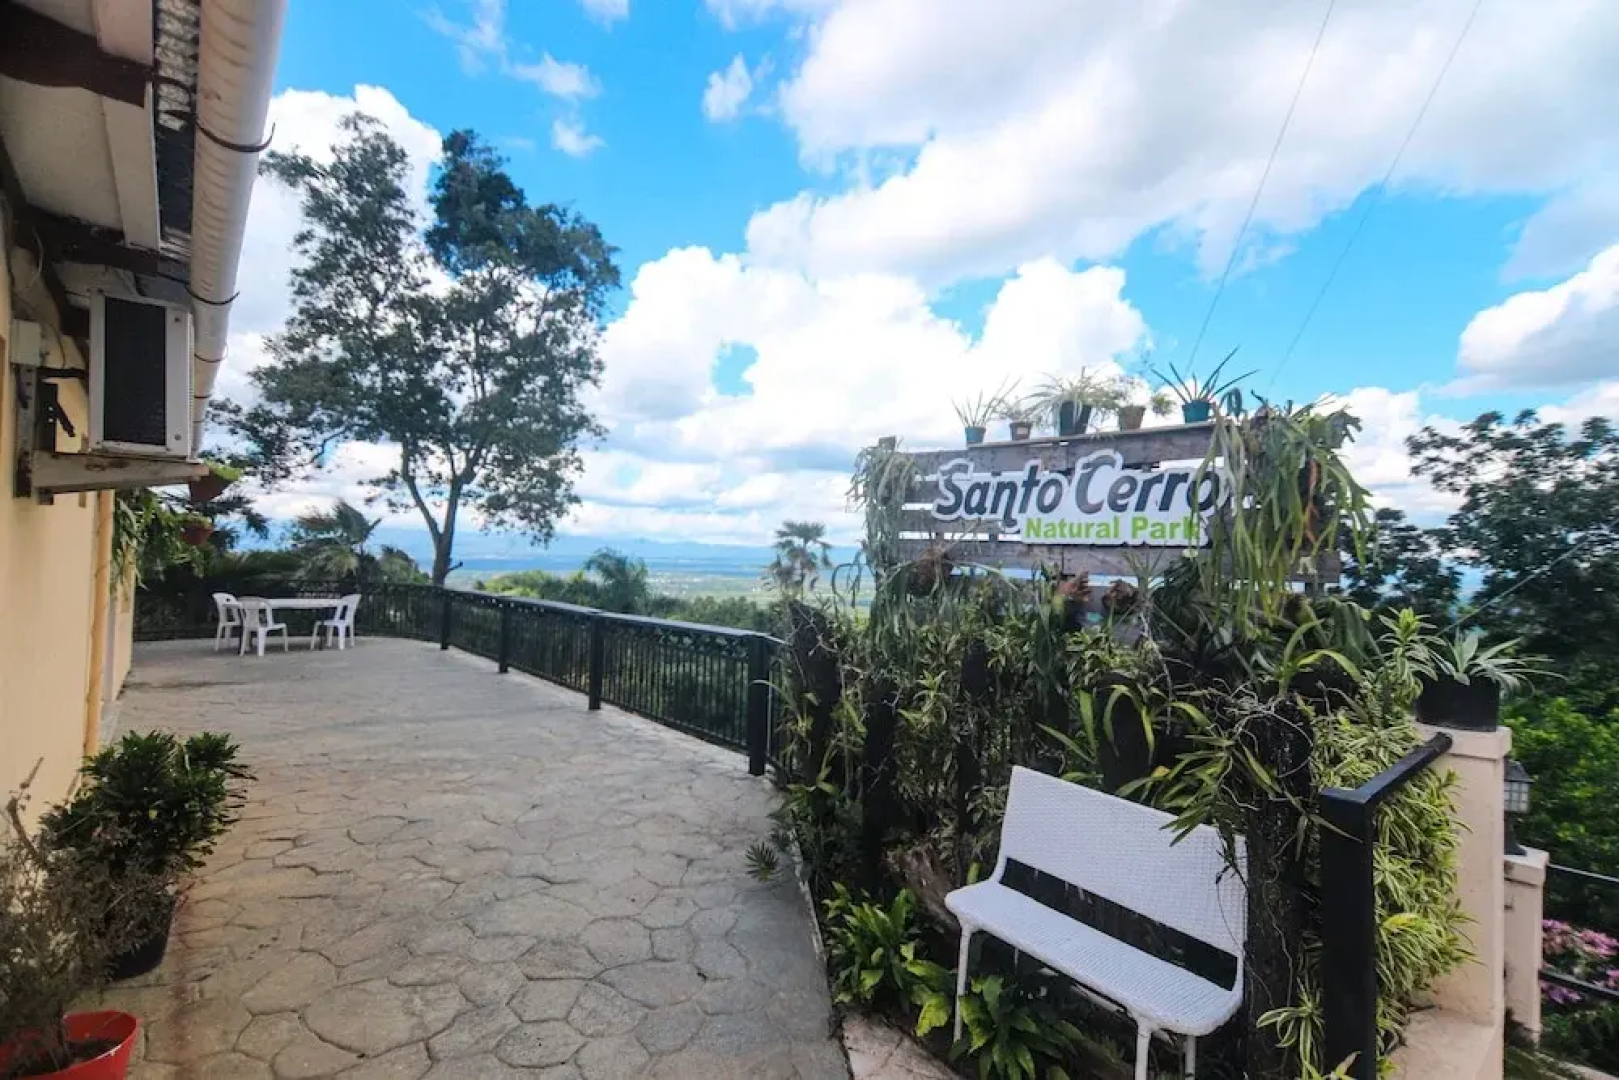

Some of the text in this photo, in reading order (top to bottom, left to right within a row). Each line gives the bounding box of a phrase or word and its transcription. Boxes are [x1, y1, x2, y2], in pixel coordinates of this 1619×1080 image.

[936, 454, 1221, 529] Santo Cerro
[1025, 515, 1200, 540] Natural Park
